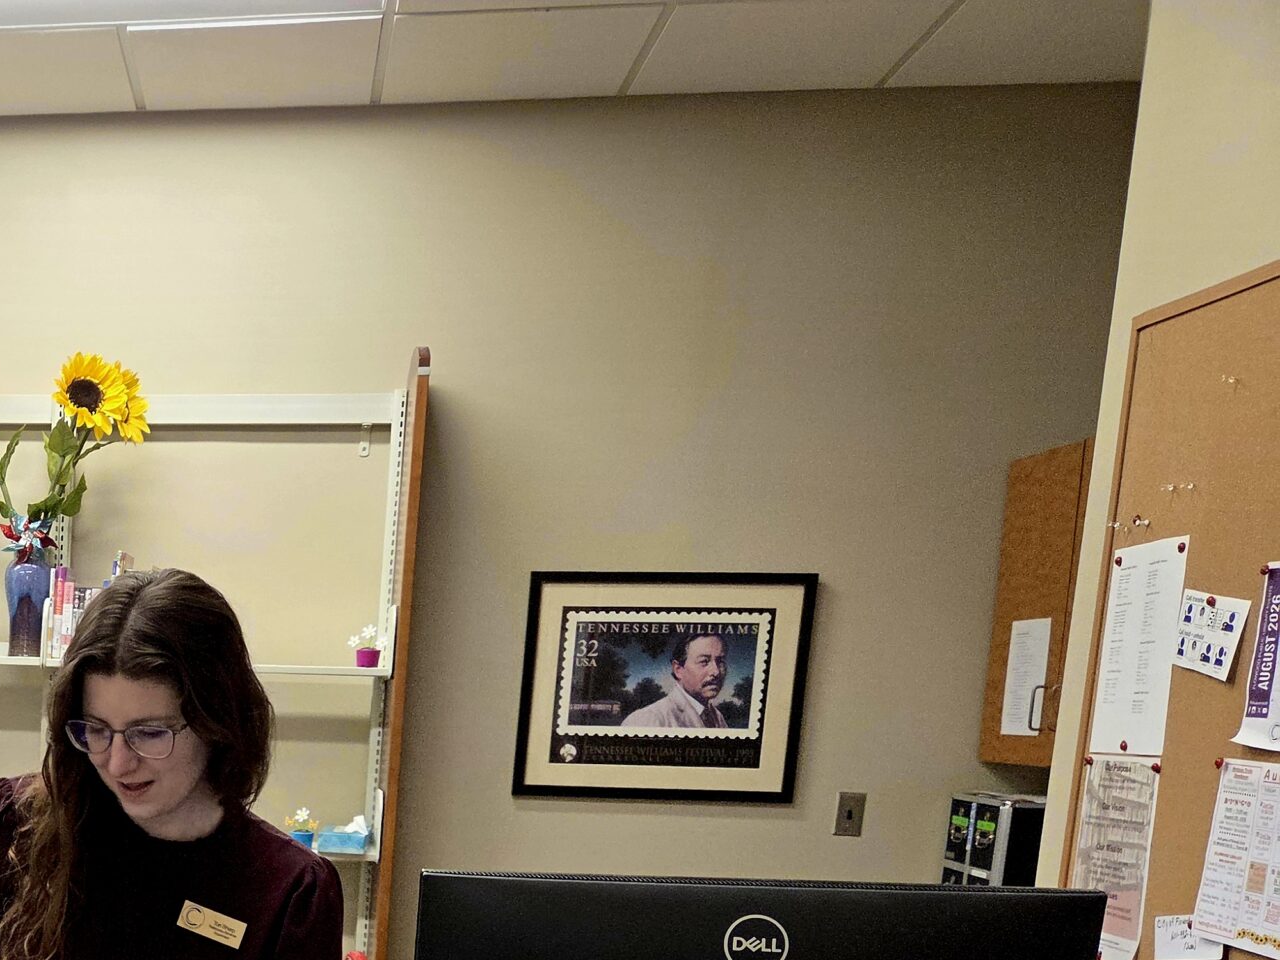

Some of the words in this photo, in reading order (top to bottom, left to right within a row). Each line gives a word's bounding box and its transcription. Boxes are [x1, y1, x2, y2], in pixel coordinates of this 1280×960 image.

[577, 623, 670, 634] TENNESSEE
[676, 624, 759, 635] WILLIAMS
[576, 640, 599, 658] 32
[575, 658, 598, 667] USA
[1258, 636, 1276, 690] AUGUST
[733, 936, 782, 952] DELL
